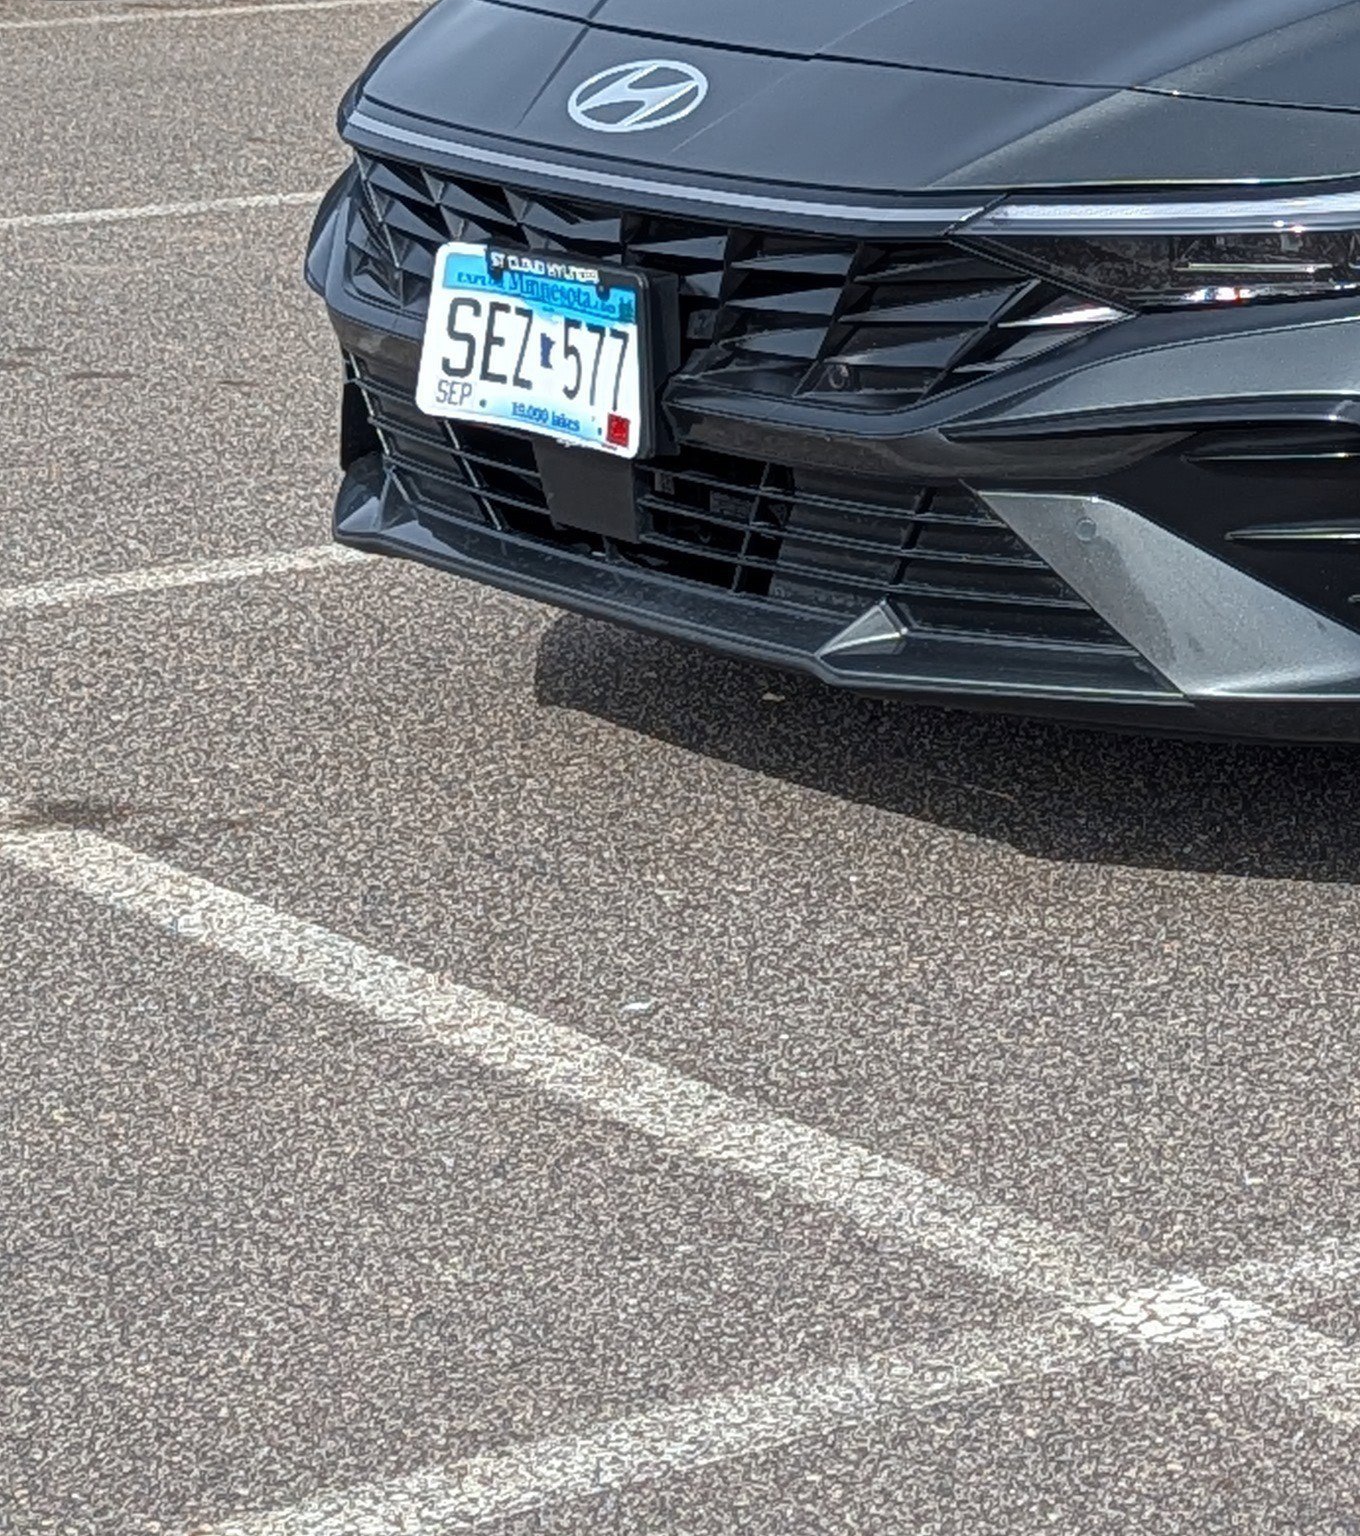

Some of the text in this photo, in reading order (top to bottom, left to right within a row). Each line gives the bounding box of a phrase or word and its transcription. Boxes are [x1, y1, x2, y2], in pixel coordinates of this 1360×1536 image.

[507, 271, 590, 309] Minnesota
[441, 297, 630, 412] SEZ 577
[435, 379, 473, 407] SEP
